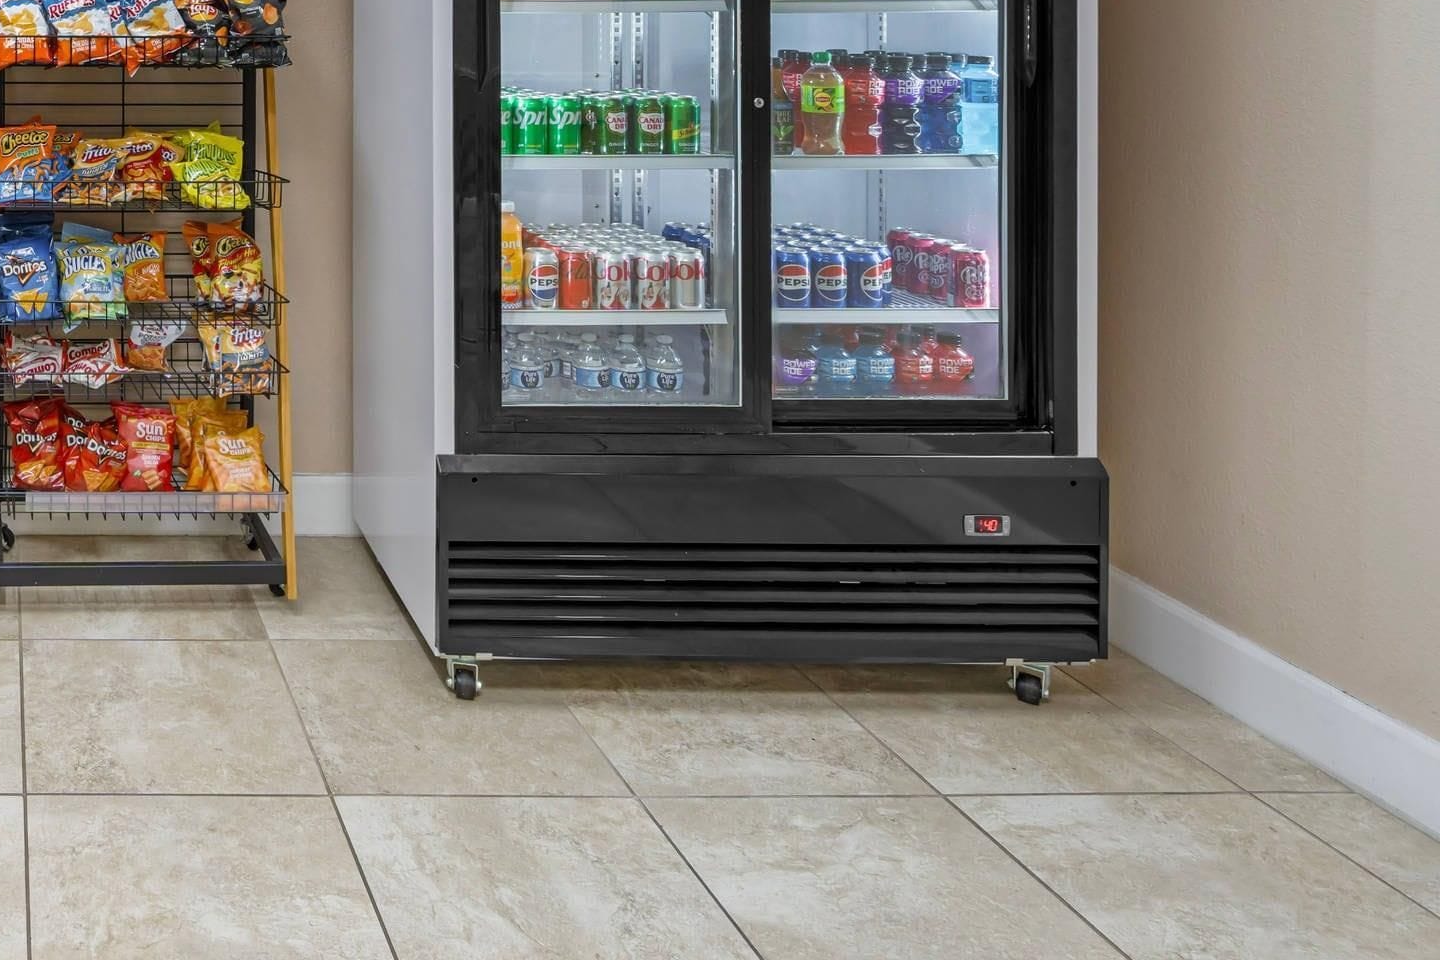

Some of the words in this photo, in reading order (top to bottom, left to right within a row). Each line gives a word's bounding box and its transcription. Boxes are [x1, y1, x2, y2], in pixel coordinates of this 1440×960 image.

[1, 130, 49, 156] Cheetos
[2, 261, 48, 277] Doritos
[62, 255, 106, 280] BUGLES
[529, 278, 558, 287] PEPS
[817, 278, 848, 287] PEPS
[863, 278, 882, 287] PEP
[624, 377, 636, 385] Life
[661, 378, 673, 386] Life
[136, 421, 164, 438] Sun
[145, 434, 167, 442] CHIPS
[87, 438, 127, 460] Doritos
[218, 438, 246, 454] Sun
[984, 519, 998, 532] 40
